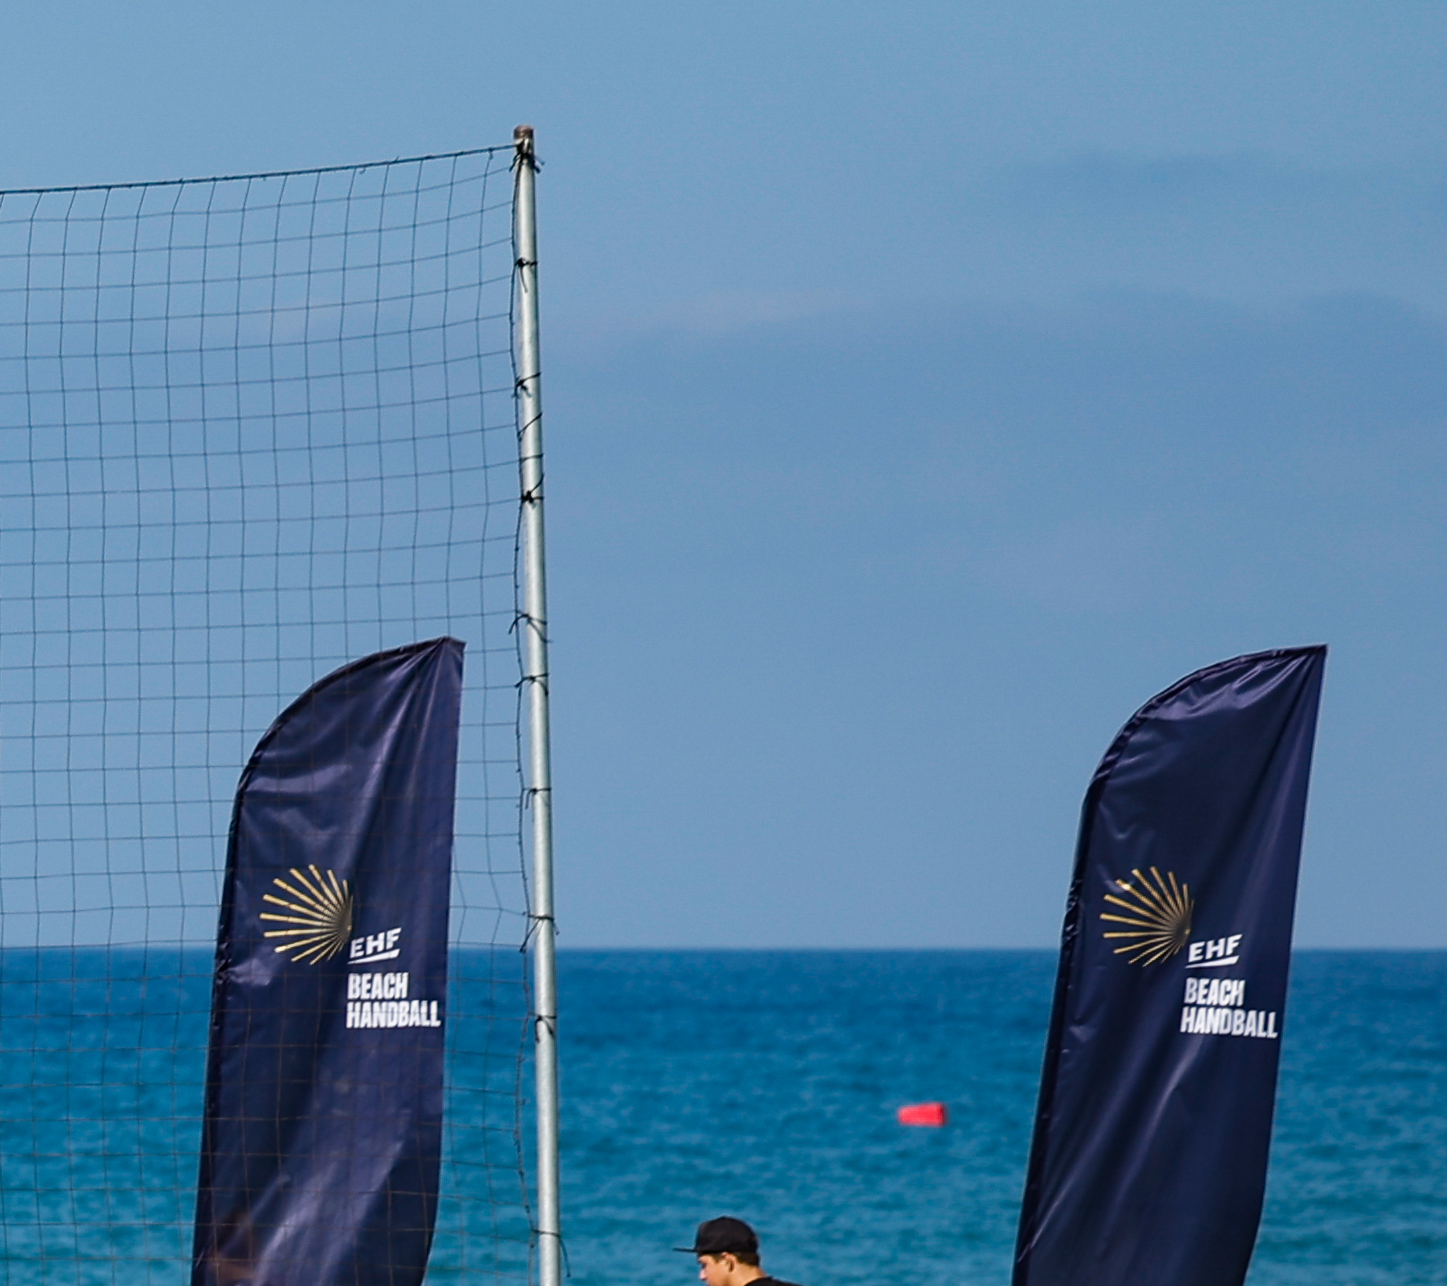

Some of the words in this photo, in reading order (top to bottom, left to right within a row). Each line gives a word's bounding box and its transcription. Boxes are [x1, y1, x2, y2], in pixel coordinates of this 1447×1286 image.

[350, 927, 402, 959] EHF
[1188, 934, 1243, 962] EHF
[348, 972, 408, 999] BEACH
[1184, 978, 1245, 1006] BEACH
[346, 1000, 441, 1028] HANDBALL
[1180, 1007, 1278, 1039] HANDBALL
